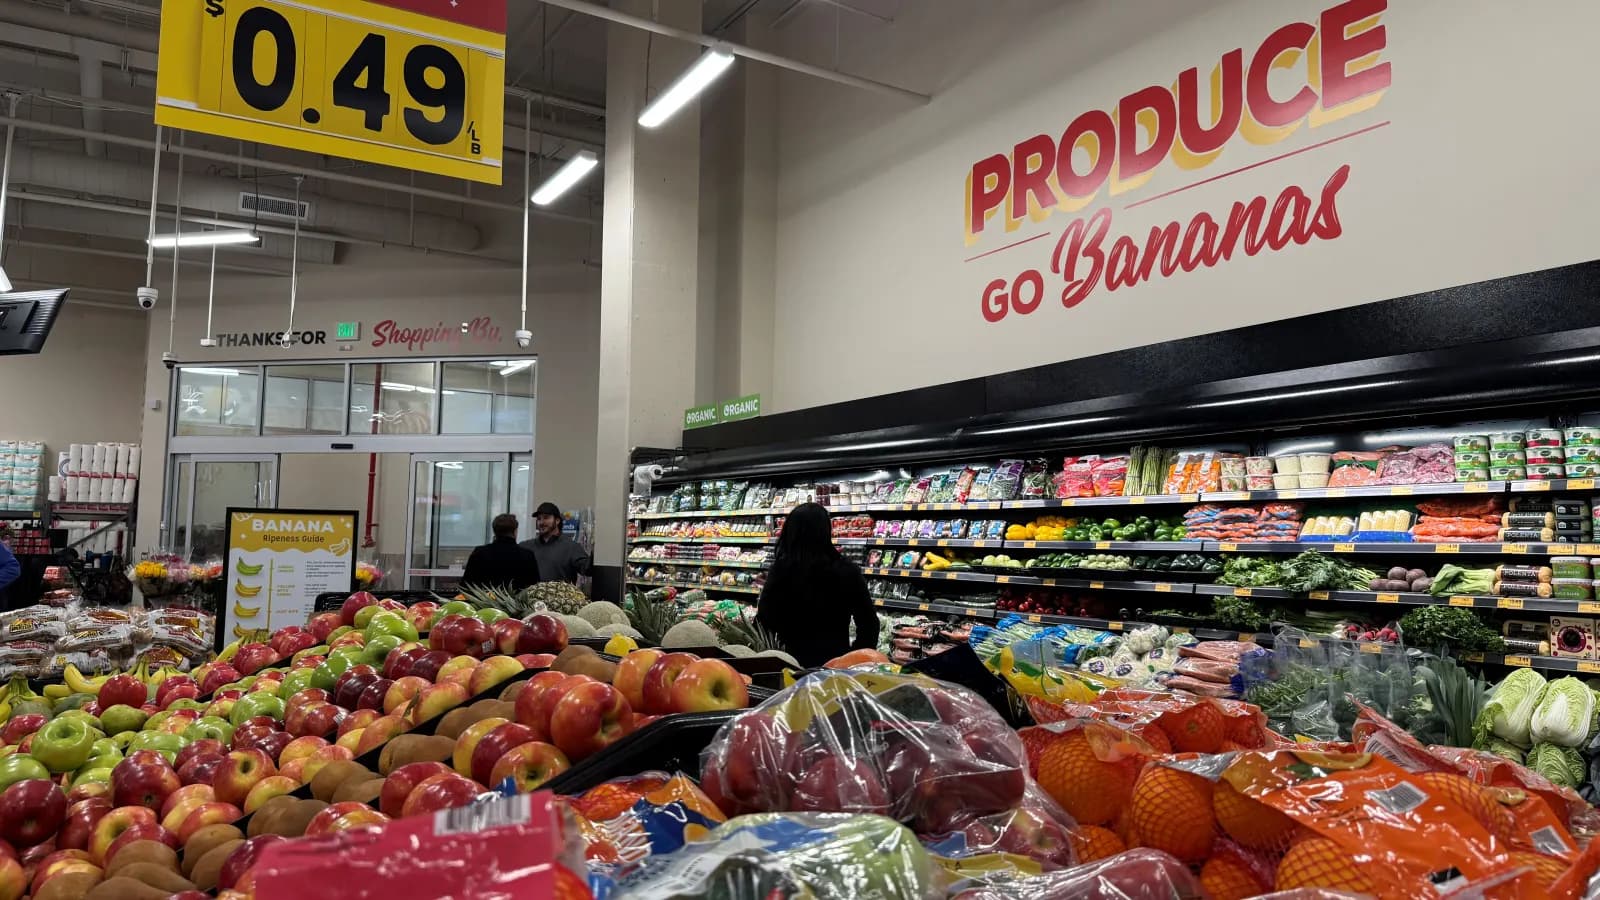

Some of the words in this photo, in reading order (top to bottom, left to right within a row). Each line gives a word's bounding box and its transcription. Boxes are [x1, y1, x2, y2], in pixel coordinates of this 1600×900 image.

[232, 6, 466, 146] 0.49
[968, 0, 1391, 240] PRODUCE
[981, 269, 1044, 323] GO
[1050, 164, 1351, 309] Bananas
[216, 332, 286, 347] THANKS
[723, 399, 758, 416] ORGANIC
[686, 408, 716, 424] ORGANIC
[252, 519, 334, 532] BANANA
[263, 534, 299, 543] Ripeness
[301, 535, 325, 543] Guide
